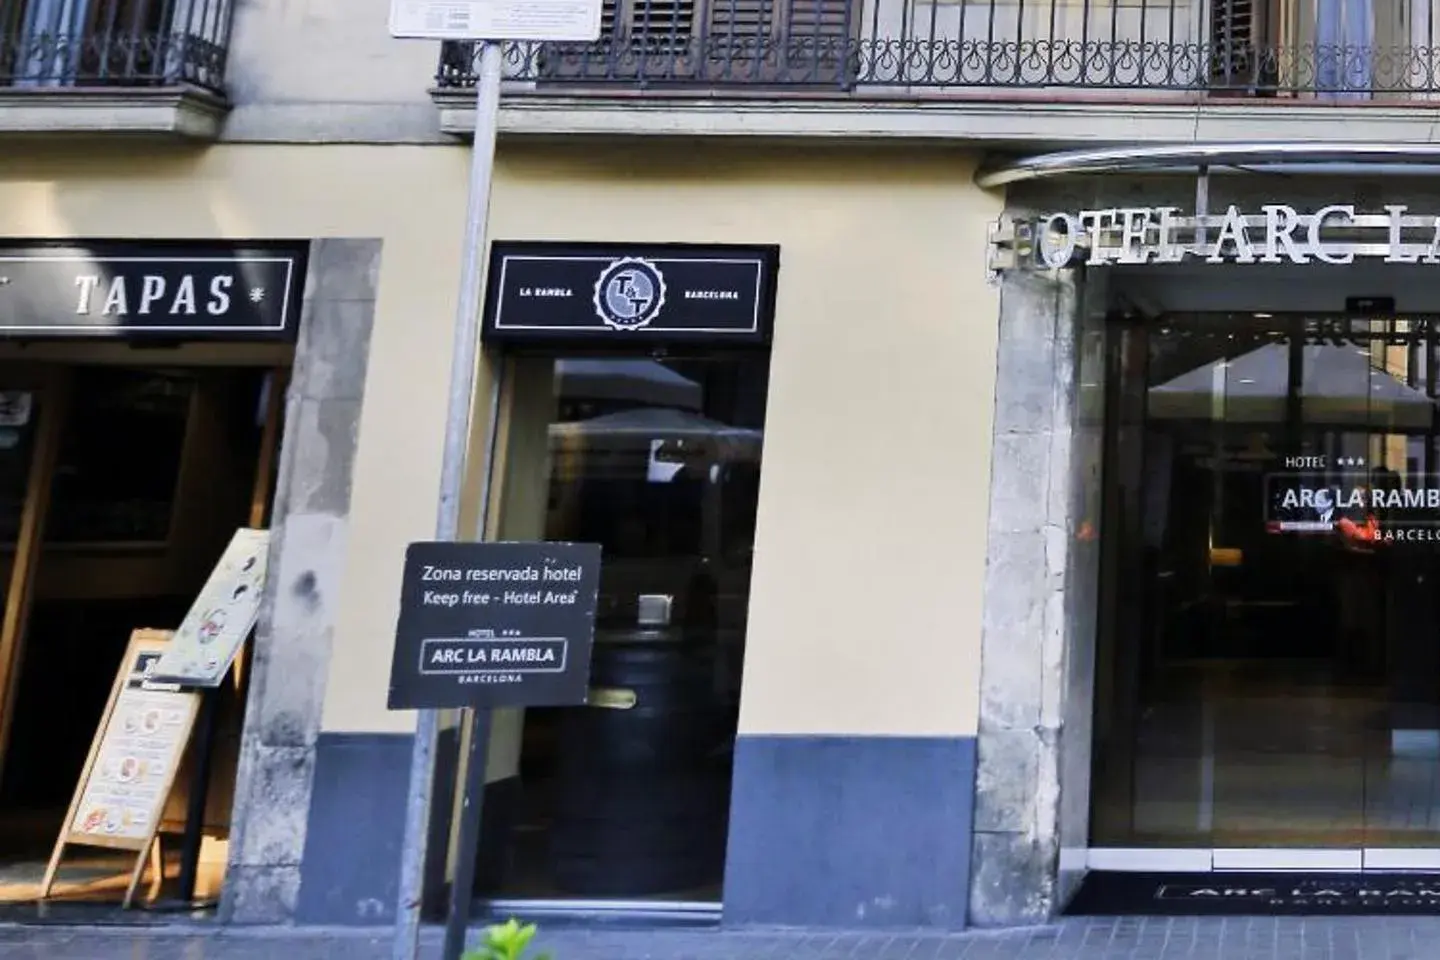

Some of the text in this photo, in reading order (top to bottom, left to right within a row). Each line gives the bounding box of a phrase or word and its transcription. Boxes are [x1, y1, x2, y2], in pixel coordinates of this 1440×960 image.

[1206, 204, 1355, 265] ARC
[75, 275, 233, 315] TAPAS
[519, 287, 532, 297] LA
[684, 290, 739, 300] BARCELONA
[1285, 456, 1326, 468] HOTEL
[1282, 488, 1333, 508] ARC
[1335, 488, 1365, 508] LA
[421, 566, 582, 581] Zona reservada hotel
[423, 591, 459, 607] Keep
[462, 591, 490, 605] free
[504, 591, 541, 604] Hotel
[544, 591, 576, 604] Area
[432, 648, 555, 663] ARC LA RAMBLA
[458, 674, 522, 684] BARCELONA
